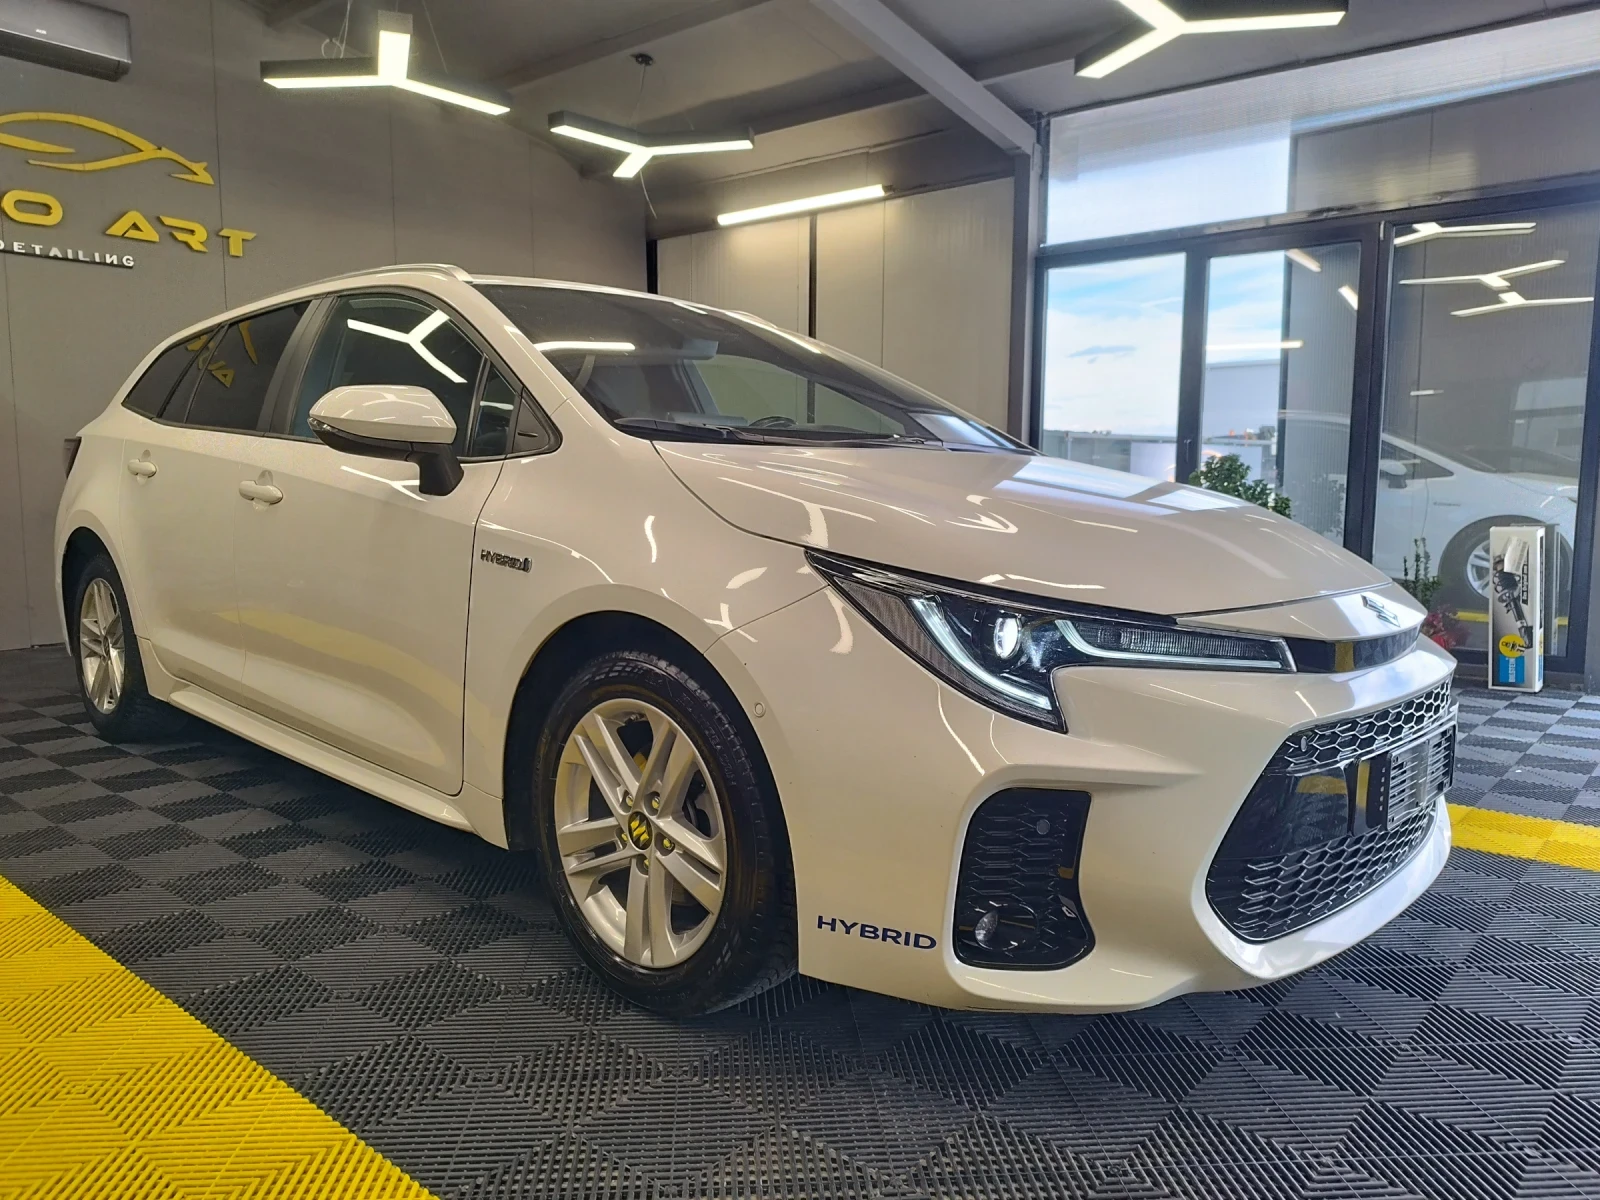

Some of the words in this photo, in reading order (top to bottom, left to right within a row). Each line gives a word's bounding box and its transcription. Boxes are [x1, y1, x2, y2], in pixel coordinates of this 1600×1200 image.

[105, 210, 256, 257] ART
[481, 548, 524, 571] HYBRID
[817, 915, 937, 950] HYBRID
